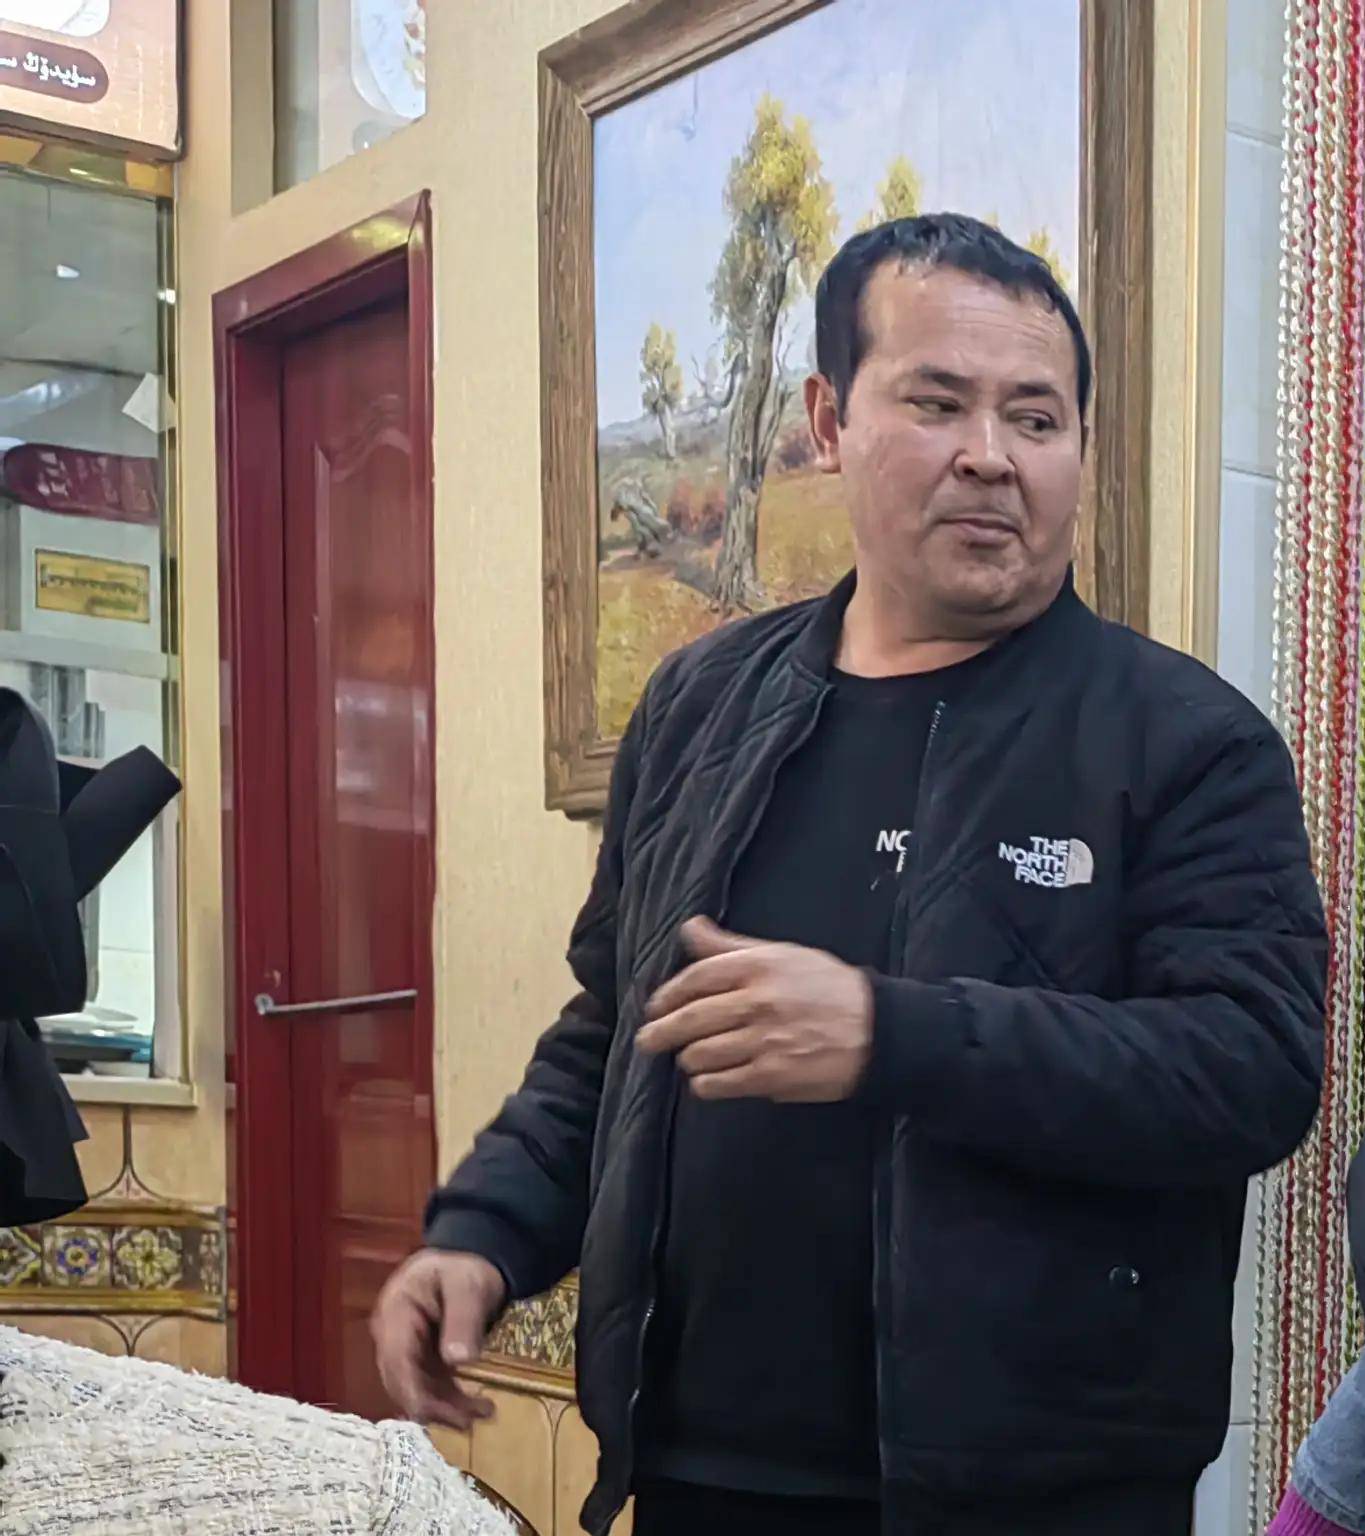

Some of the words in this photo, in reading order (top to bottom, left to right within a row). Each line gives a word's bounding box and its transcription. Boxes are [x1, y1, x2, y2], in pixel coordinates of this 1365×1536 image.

[998, 841, 1067, 870] NORTH
[1029, 835, 1070, 855] THE
[1014, 865, 1067, 889] FACE
